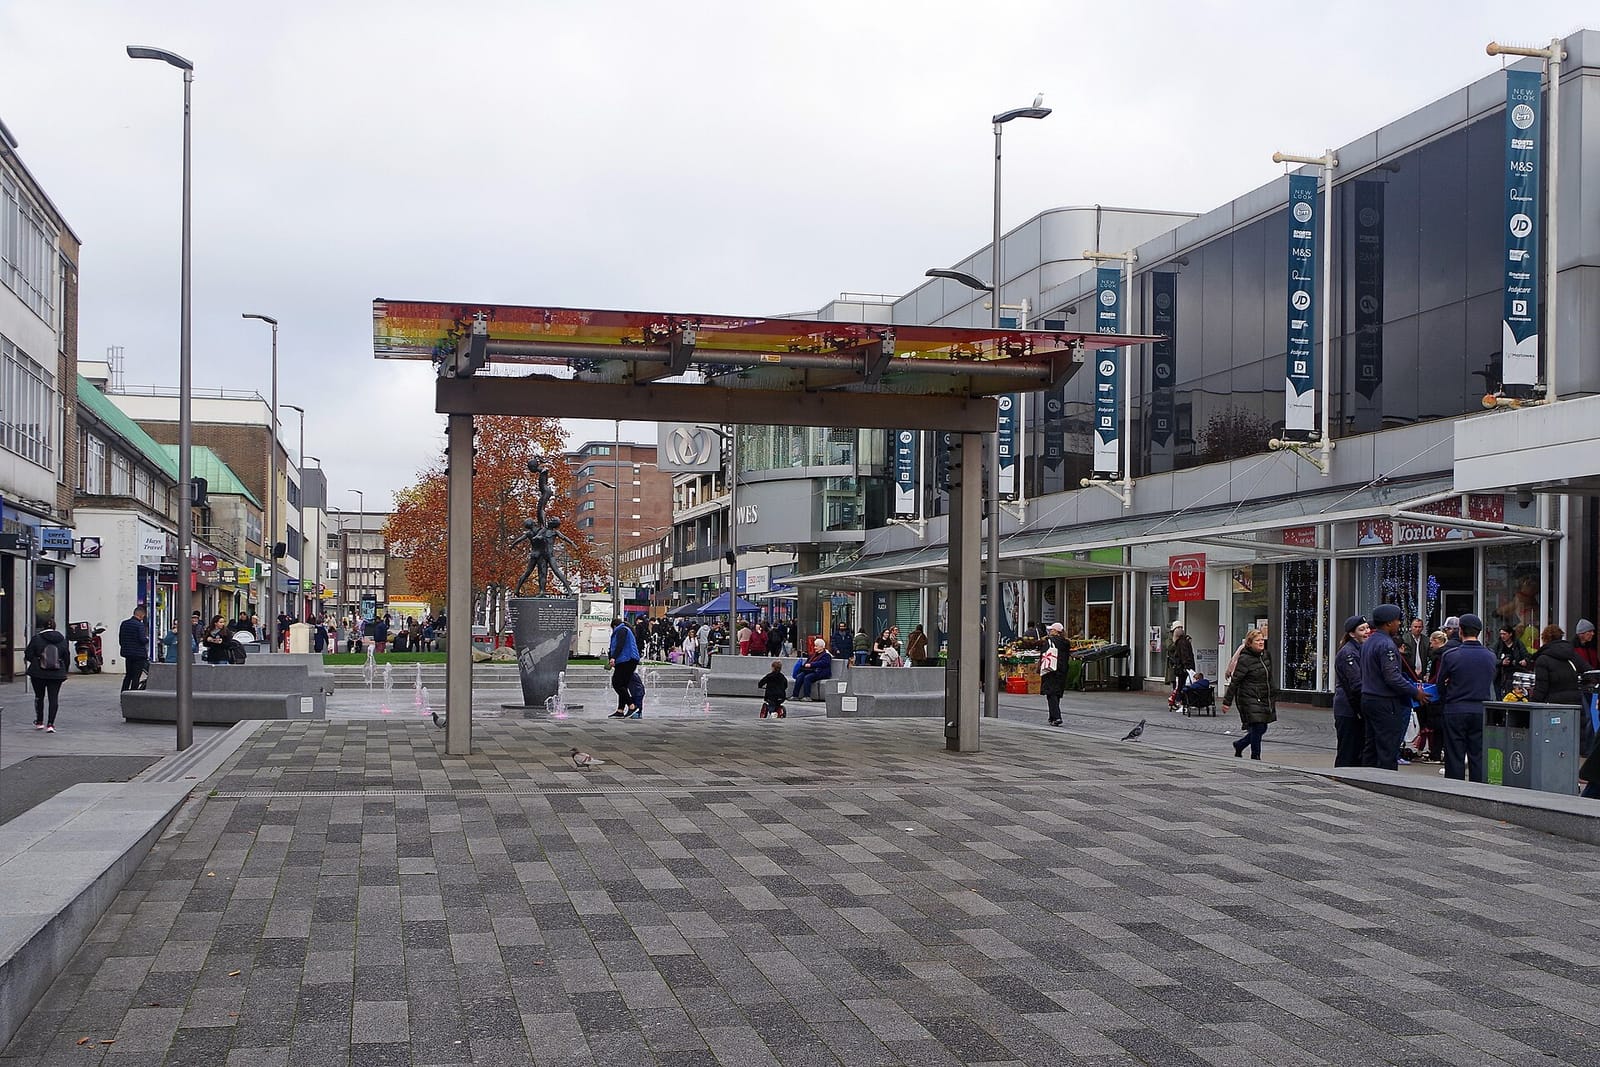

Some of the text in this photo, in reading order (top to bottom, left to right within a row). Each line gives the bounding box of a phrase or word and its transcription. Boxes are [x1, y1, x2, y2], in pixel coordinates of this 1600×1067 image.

[1511, 93, 1535, 101] LOOK
[1510, 160, 1534, 172] M&S
[1513, 219, 1529, 233] JD
[1292, 247, 1312, 258] M&S
[1295, 295, 1308, 305] JD
[1099, 326, 1116, 334] M&S
[1101, 364, 1113, 372] JD
[728, 505, 758, 525] WES
[145, 537, 161, 545] Hays
